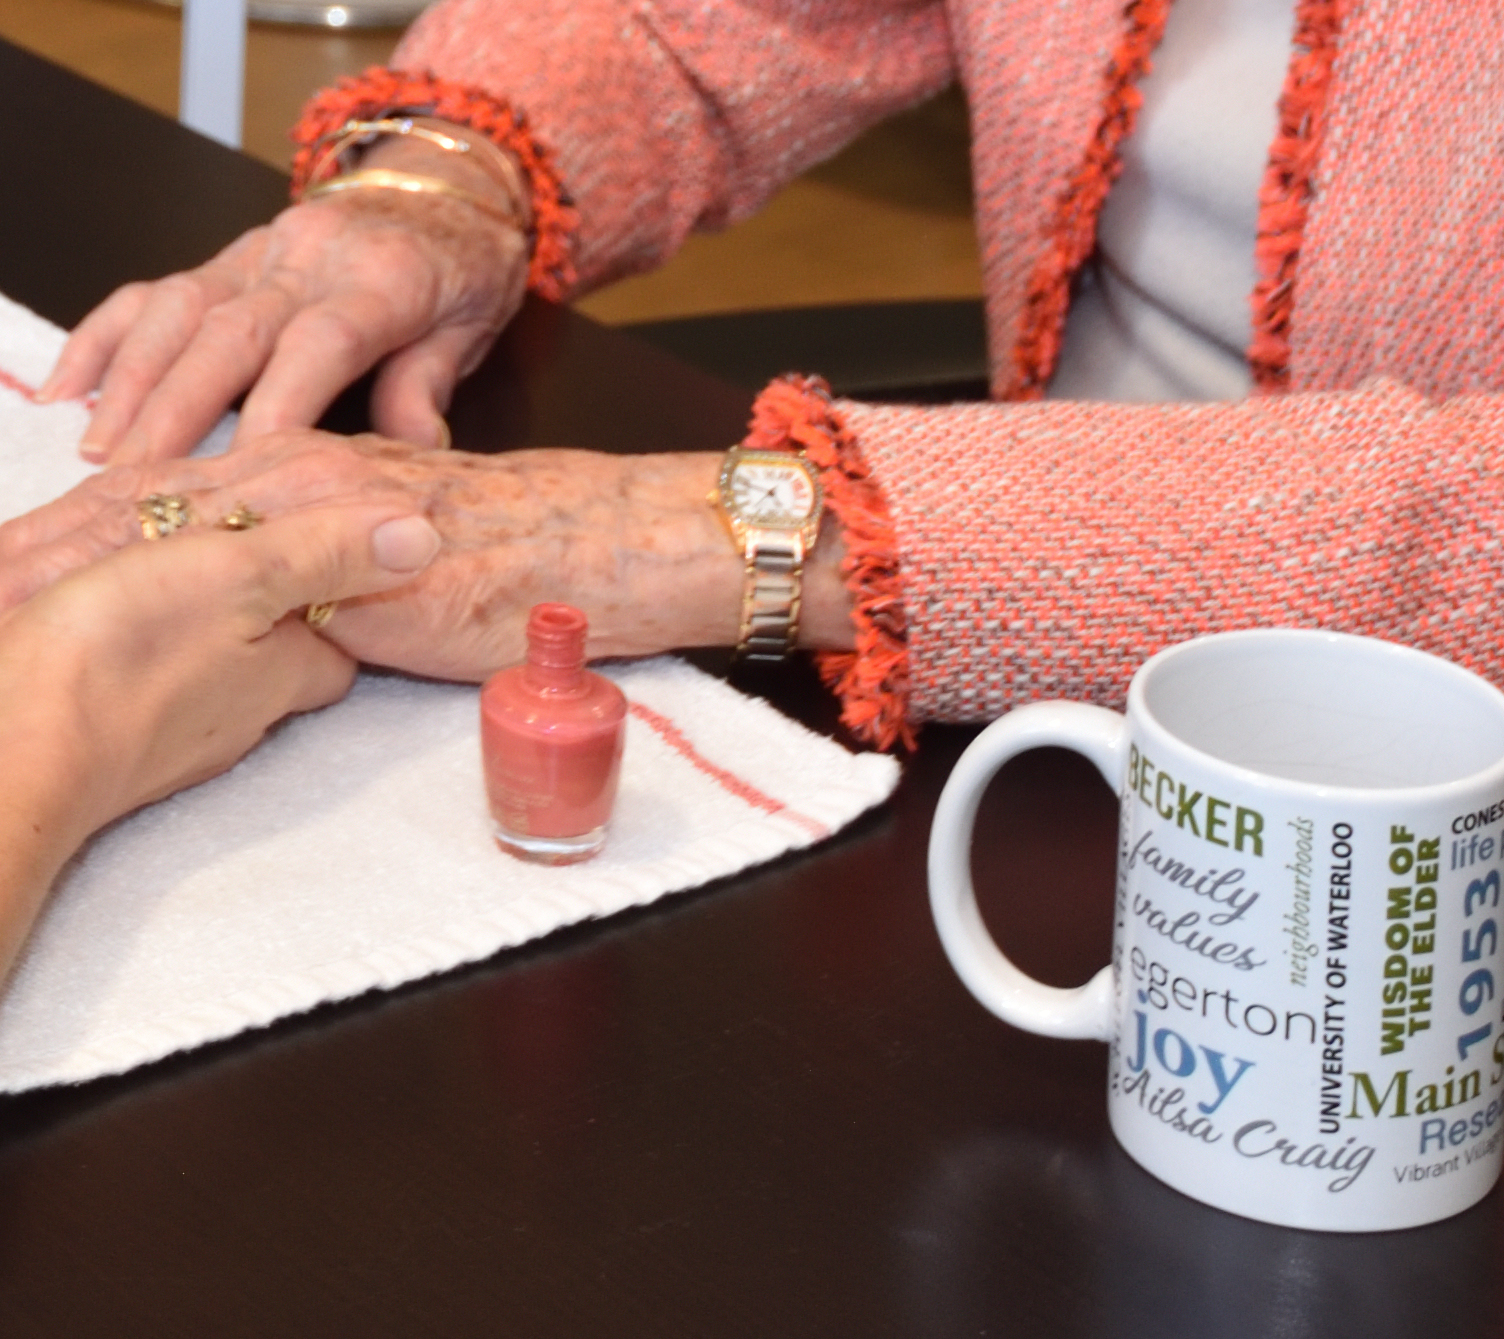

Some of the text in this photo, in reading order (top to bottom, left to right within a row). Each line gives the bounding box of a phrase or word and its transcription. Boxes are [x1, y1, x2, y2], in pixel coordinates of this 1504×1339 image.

[1127, 744, 1265, 858] BECKER
[1450, 834, 1495, 871] life
[1128, 830, 1261, 926] family
[1132, 892, 1267, 972] values
[1282, 815, 1318, 988] neighbourhoods
[1408, 836, 1441, 1038] THE ELDER
[1130, 945, 1317, 1045] egerton
[1319, 822, 1353, 1134] UNIVERSITY OF WATERLOO
[1380, 824, 1416, 1056] WISDOM OF
[1457, 869, 1501, 1062] 1953
[1126, 988, 1256, 1115] joy
[1347, 1065, 1481, 1120] Main
[1121, 1068, 1377, 1194] Ailsa Craig
[1394, 1155, 1460, 1184] Vibrant
